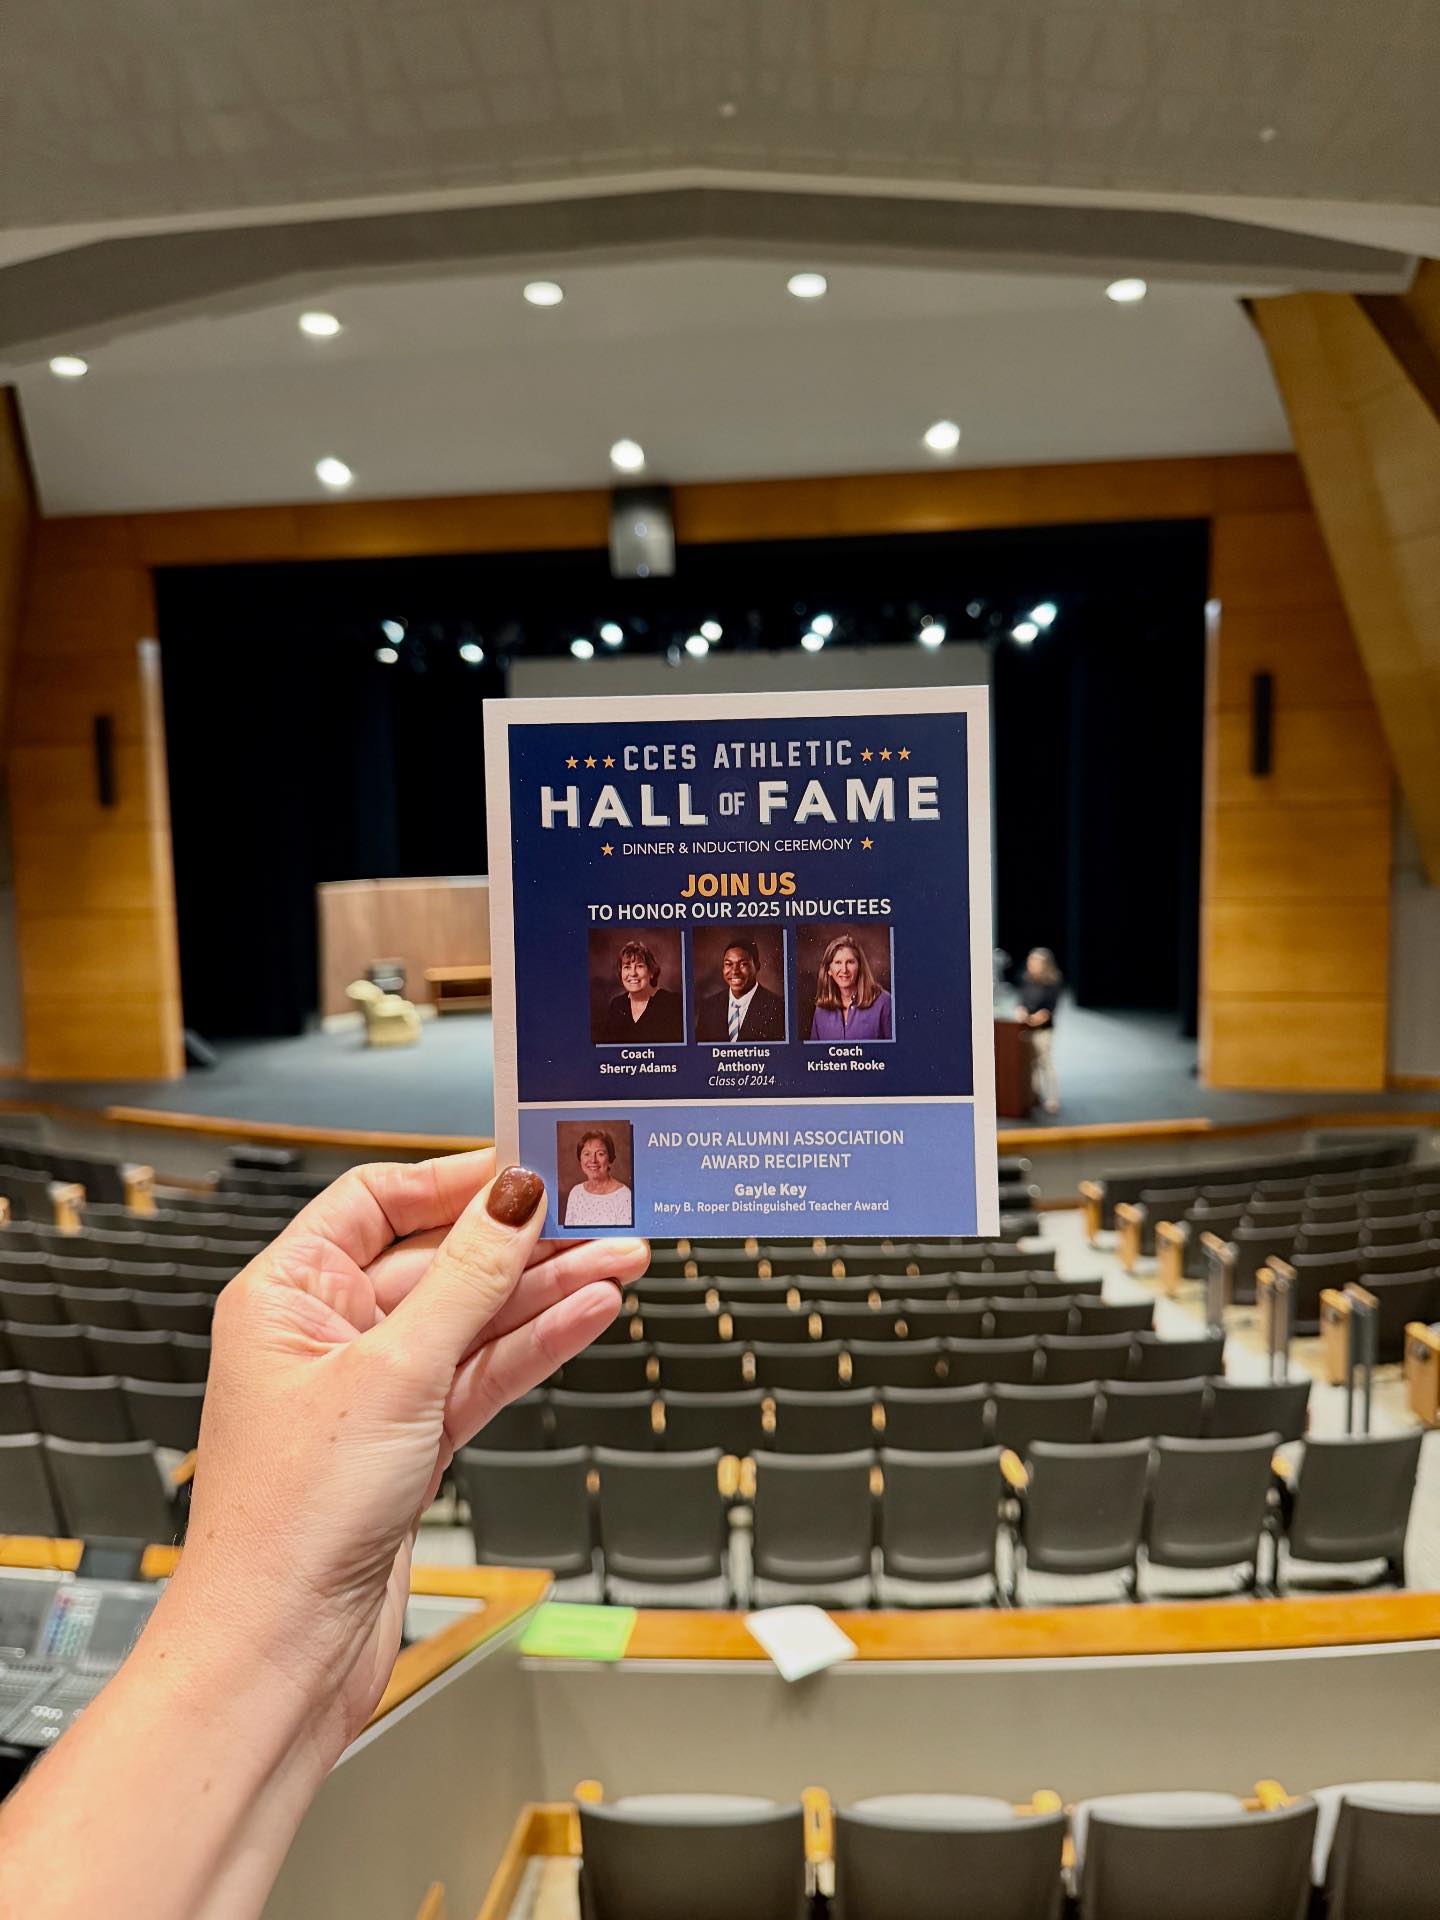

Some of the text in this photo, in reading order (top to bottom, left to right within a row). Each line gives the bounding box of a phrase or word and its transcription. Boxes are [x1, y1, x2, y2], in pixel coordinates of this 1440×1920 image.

[623, 739, 853, 771] CCES ATHLETIC
[540, 776, 941, 829] HALL OF FAME
[623, 838, 854, 856] DINNER & INDUCTION CEREMONY
[680, 872, 796, 899] JOIN US
[588, 898, 892, 922] TO HONOR OUR 2025 INDUCTEES
[620, 1048, 656, 1060] Coach
[712, 1046, 771, 1059] Demetrius
[828, 1045, 863, 1058] Coach
[599, 1062, 677, 1077] Sherry Adams
[717, 1060, 766, 1075] Anthony
[807, 1058, 886, 1072] Kristen Rooke
[708, 1074, 775, 1087] Class of 2014
[648, 1129, 904, 1147] AND OUR ALUMNI ASSOCIATION
[700, 1153, 852, 1170] AWARD RECIPIENT
[734, 1182, 808, 1200] Gayle Key
[653, 1199, 890, 1215] Mary B. Roper Distinguished Teacher Award
